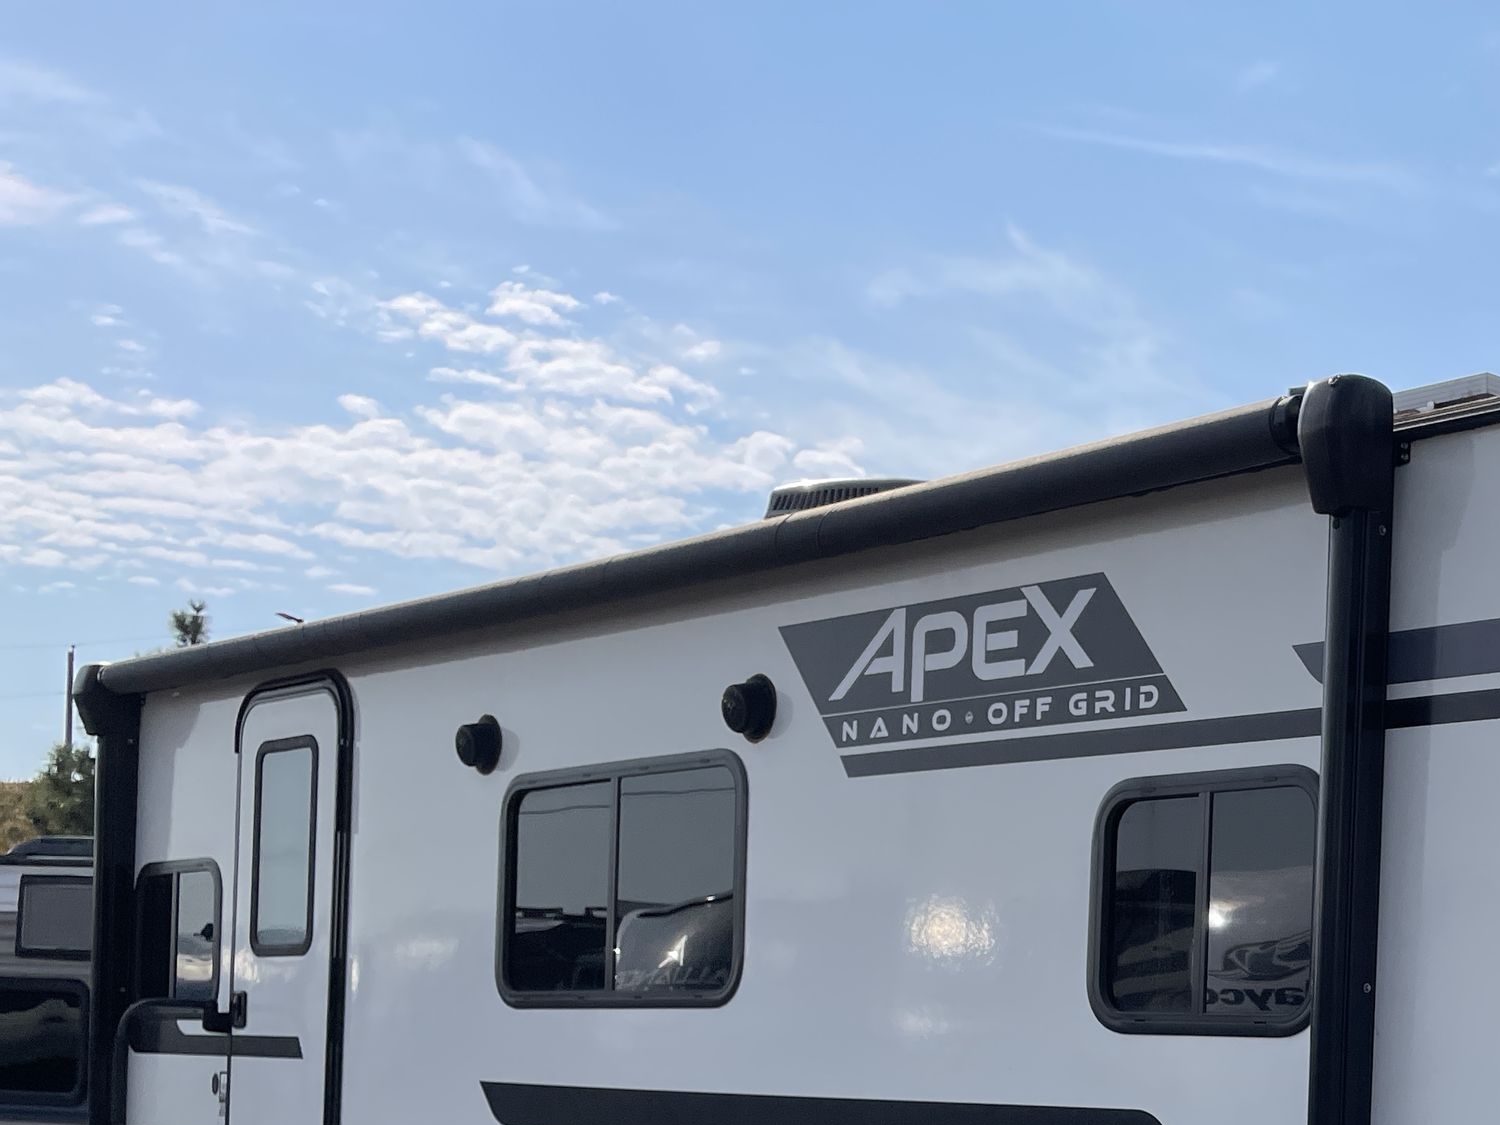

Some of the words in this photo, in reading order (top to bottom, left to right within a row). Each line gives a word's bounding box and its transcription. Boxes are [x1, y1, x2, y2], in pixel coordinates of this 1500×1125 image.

[828, 585, 1098, 703] APEX
[842, 708, 952, 743] NANO
[987, 696, 1052, 724] OFF
[1068, 684, 1159, 715] GRID
